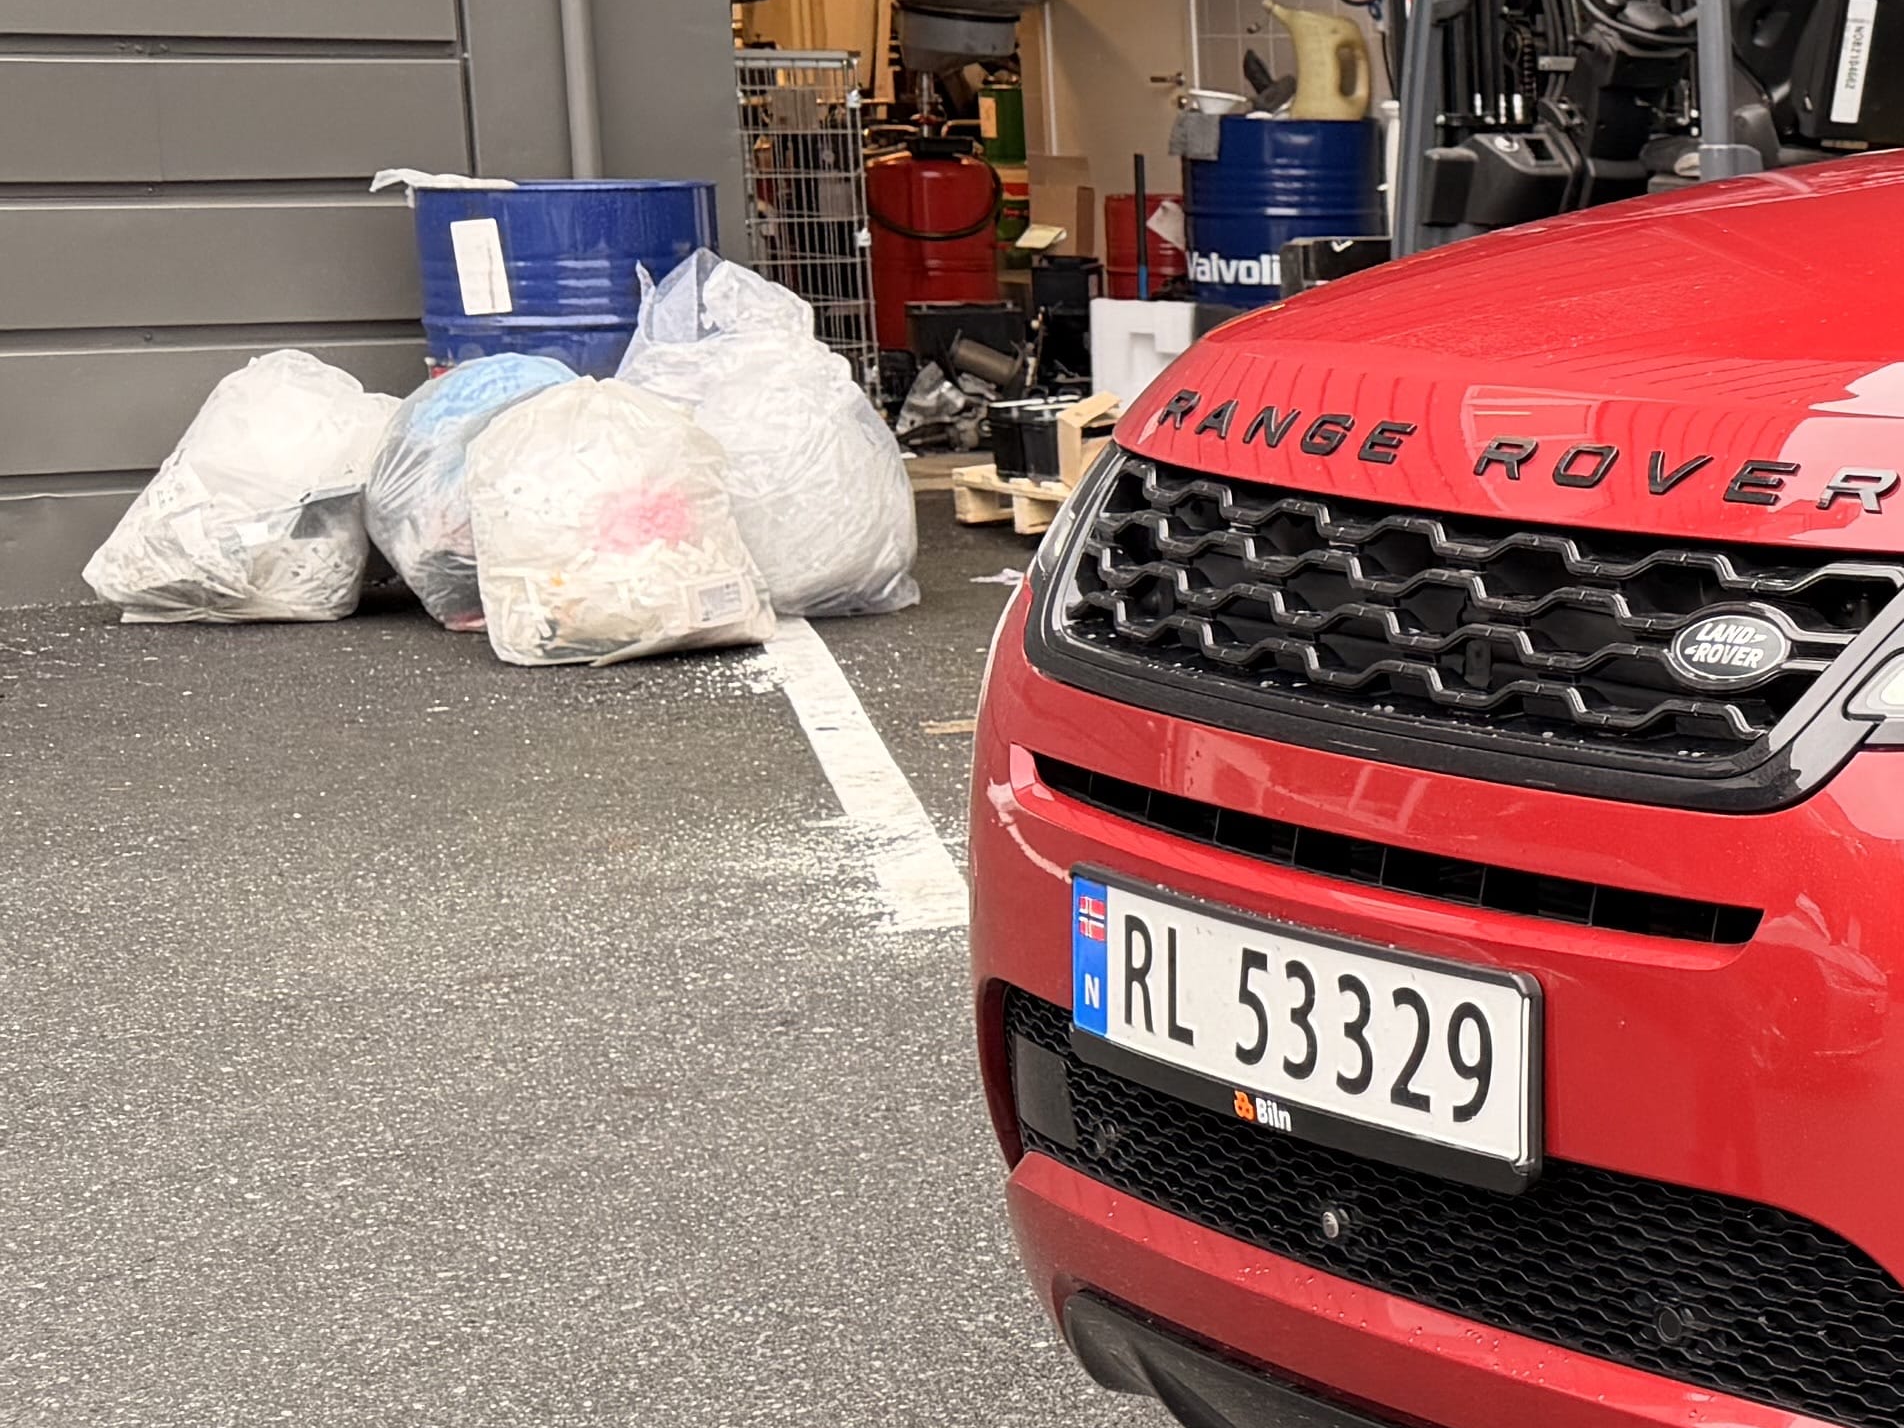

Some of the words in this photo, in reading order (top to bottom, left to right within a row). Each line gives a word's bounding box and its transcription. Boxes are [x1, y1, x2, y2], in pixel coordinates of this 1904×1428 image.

[1185, 251, 1282, 285] Valvoli
[1156, 387, 1418, 465] RANGE
[1473, 435, 1902, 515] ROVER
[1696, 623, 1757, 644] LAND
[1692, 642, 1764, 668] ROVER
[1084, 973, 1100, 1009] N
[1124, 914, 1194, 1047] RL
[1235, 947, 1493, 1123] 53329
